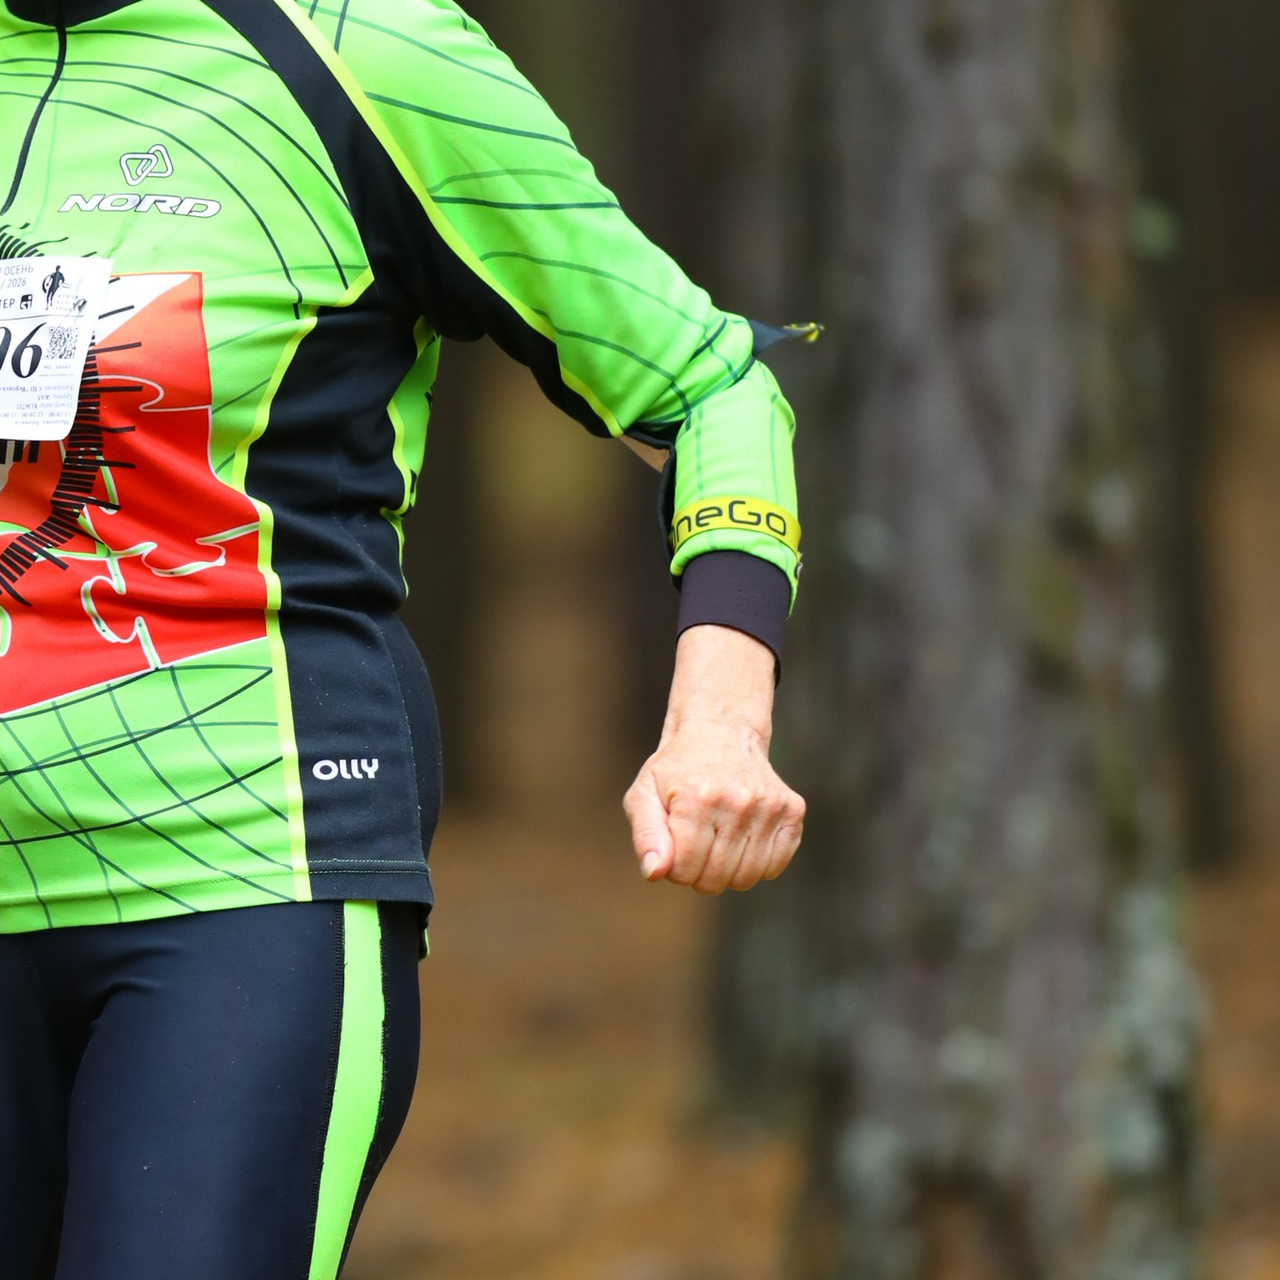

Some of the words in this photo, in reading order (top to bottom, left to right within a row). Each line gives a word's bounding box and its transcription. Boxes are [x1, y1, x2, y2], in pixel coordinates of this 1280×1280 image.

[58, 193, 221, 218] NORD
[4, 264, 34, 276] ОСЕНЬ
[312, 758, 379, 781] OLLY
